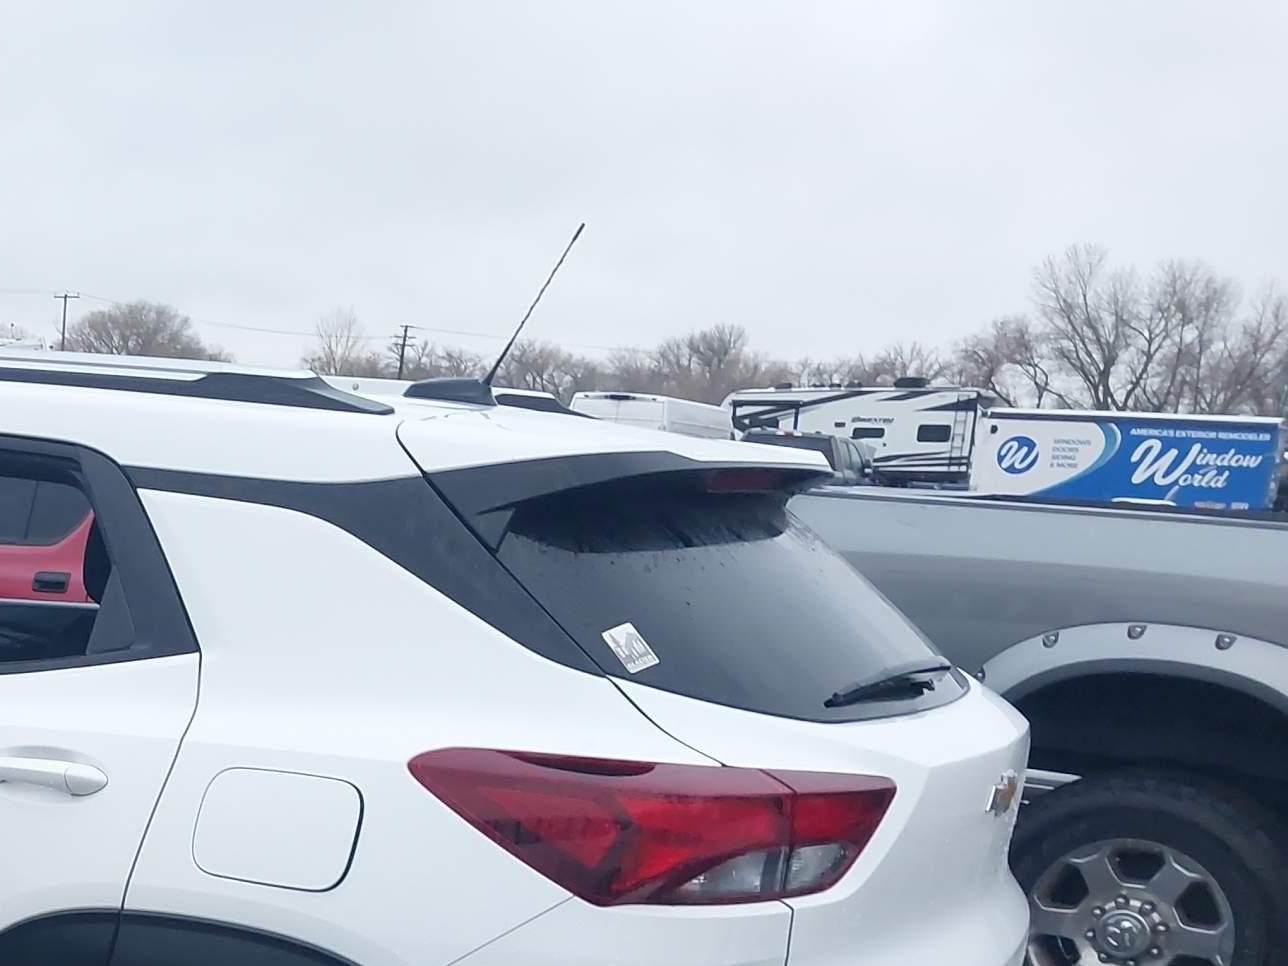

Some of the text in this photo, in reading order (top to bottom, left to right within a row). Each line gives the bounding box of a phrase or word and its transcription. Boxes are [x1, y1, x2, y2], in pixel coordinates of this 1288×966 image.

[1176, 429, 1216, 438] EXTERIOR
[1000, 440, 1038, 469] W
[1130, 439, 1262, 486] Window
